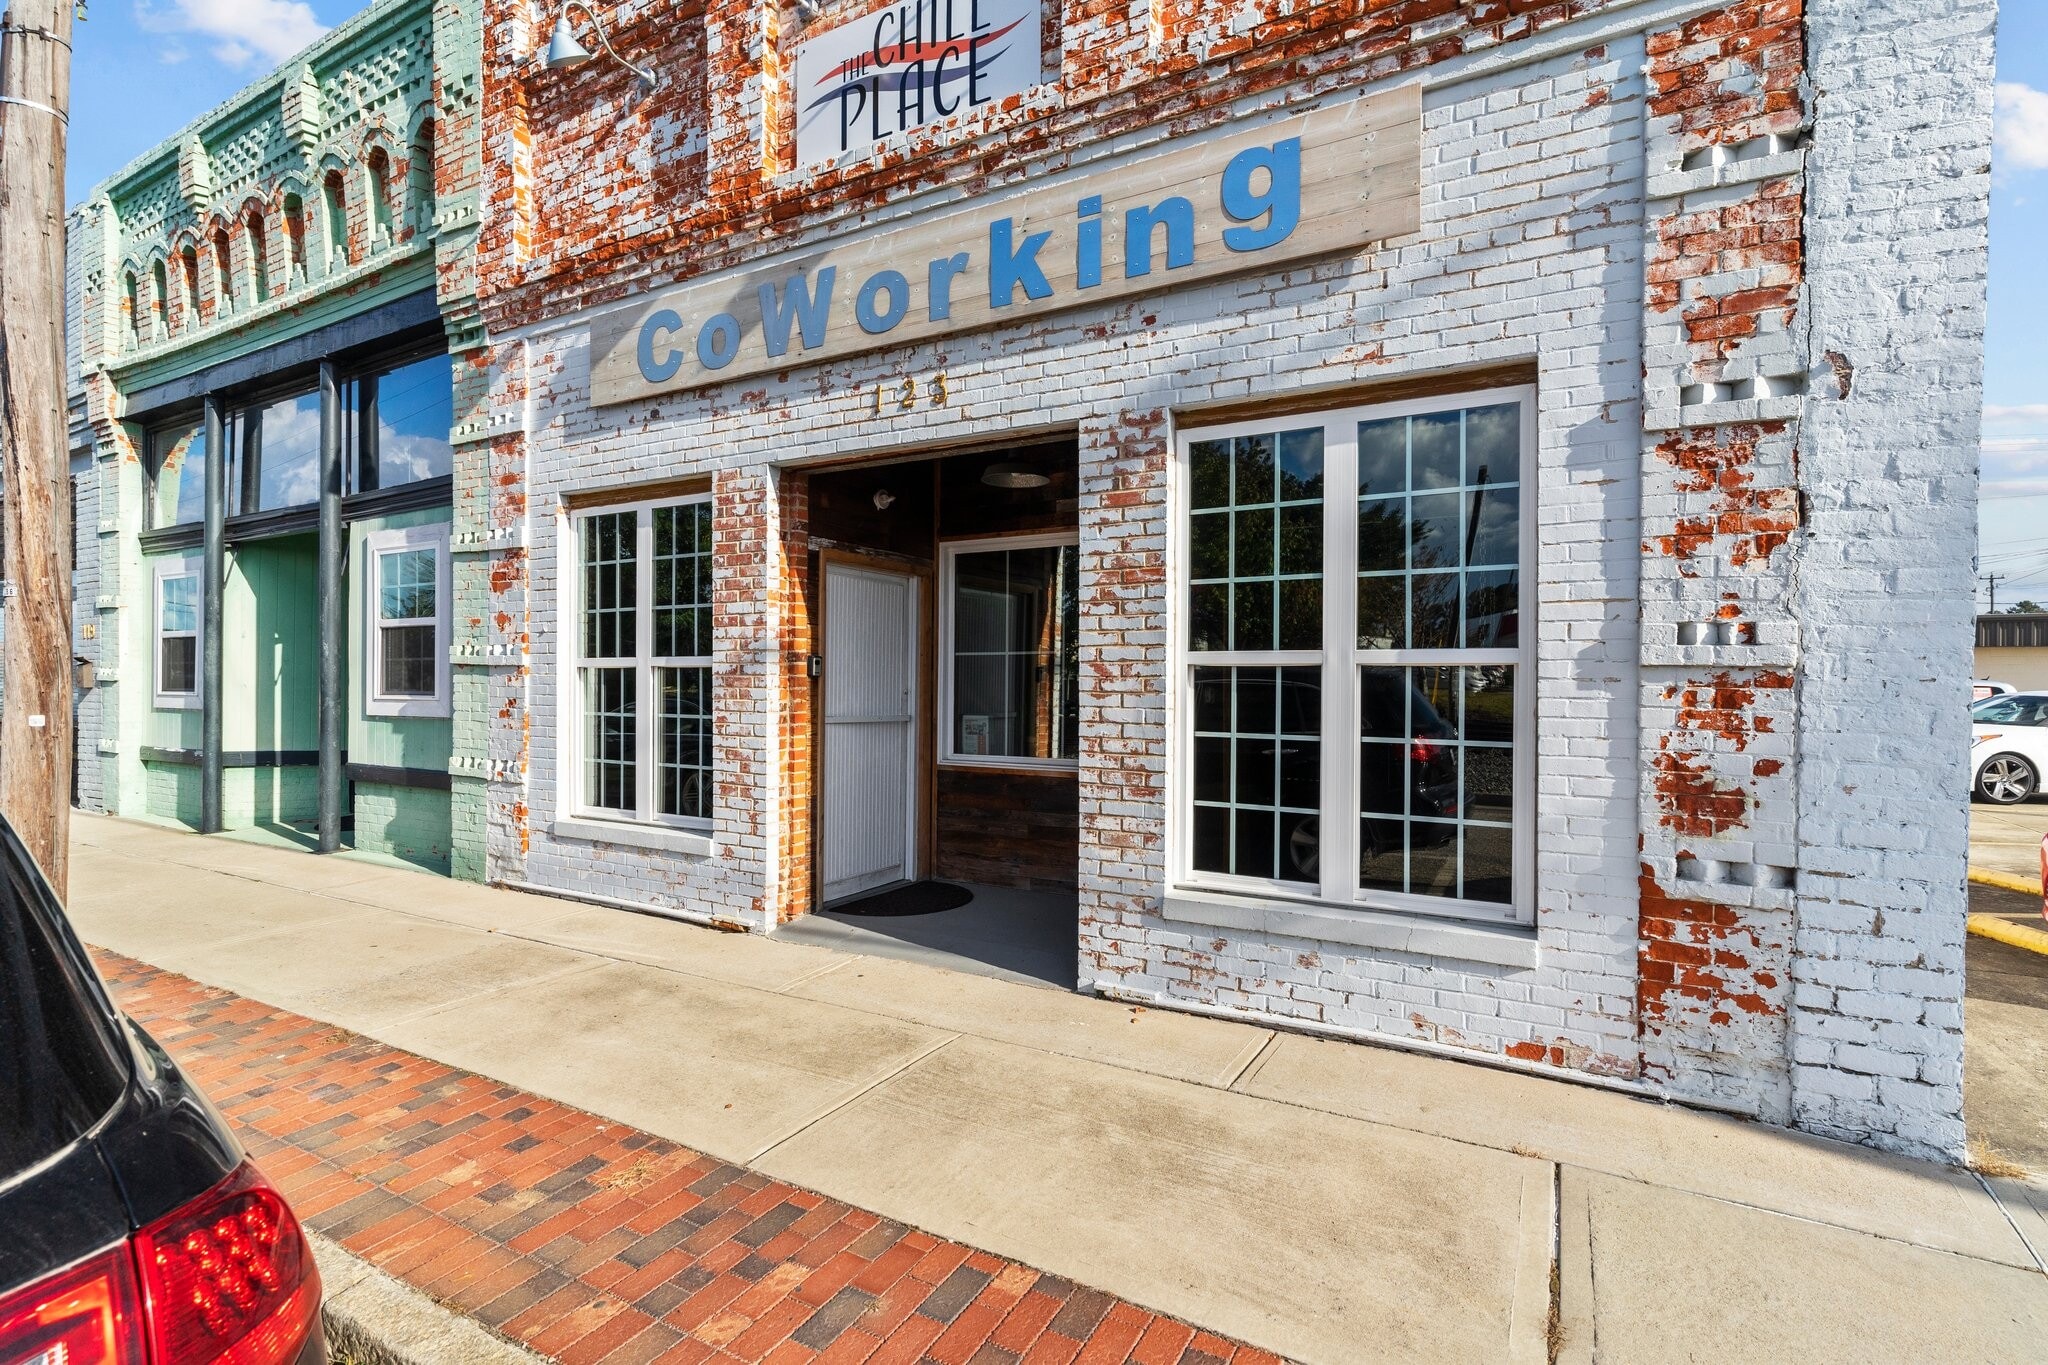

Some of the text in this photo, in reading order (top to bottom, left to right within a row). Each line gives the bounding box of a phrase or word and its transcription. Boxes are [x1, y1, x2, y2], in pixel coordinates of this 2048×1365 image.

[840, 51, 869, 83] THE
[840, 33, 991, 151] PLACE
[637, 136, 1300, 382] CoWorking
[875, 369, 948, 413] 123
